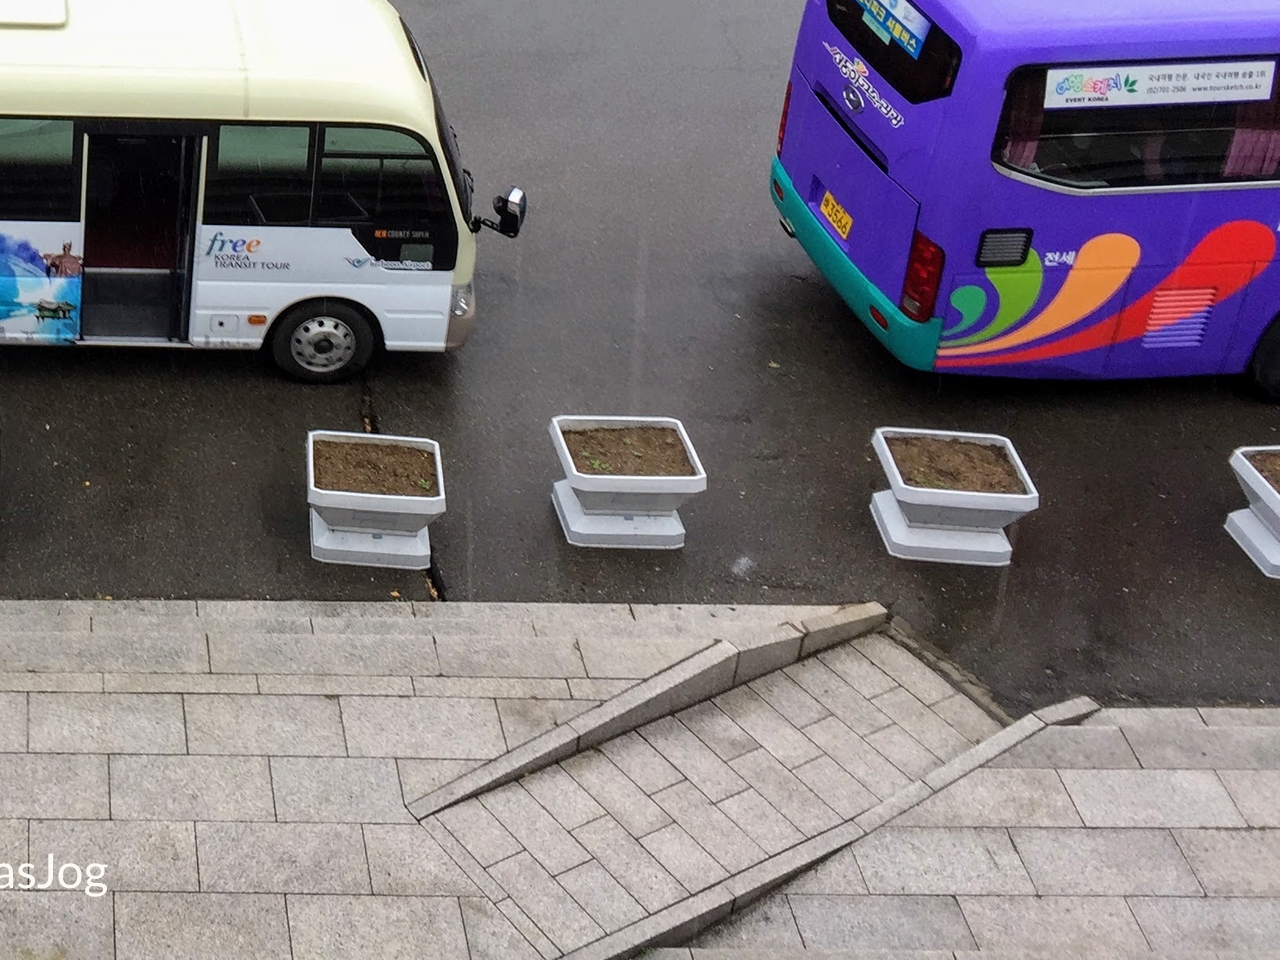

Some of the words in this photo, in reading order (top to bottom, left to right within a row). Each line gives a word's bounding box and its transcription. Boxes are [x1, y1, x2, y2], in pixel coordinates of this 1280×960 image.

[1056, 73, 1122, 95] 여행스케치
[204, 231, 262, 256] free
[214, 253, 250, 261] KOREA
[214, 260, 258, 270] TRANSIT
[260, 261, 291, 270] TOUR
[1044, 251, 1076, 267] 전세
